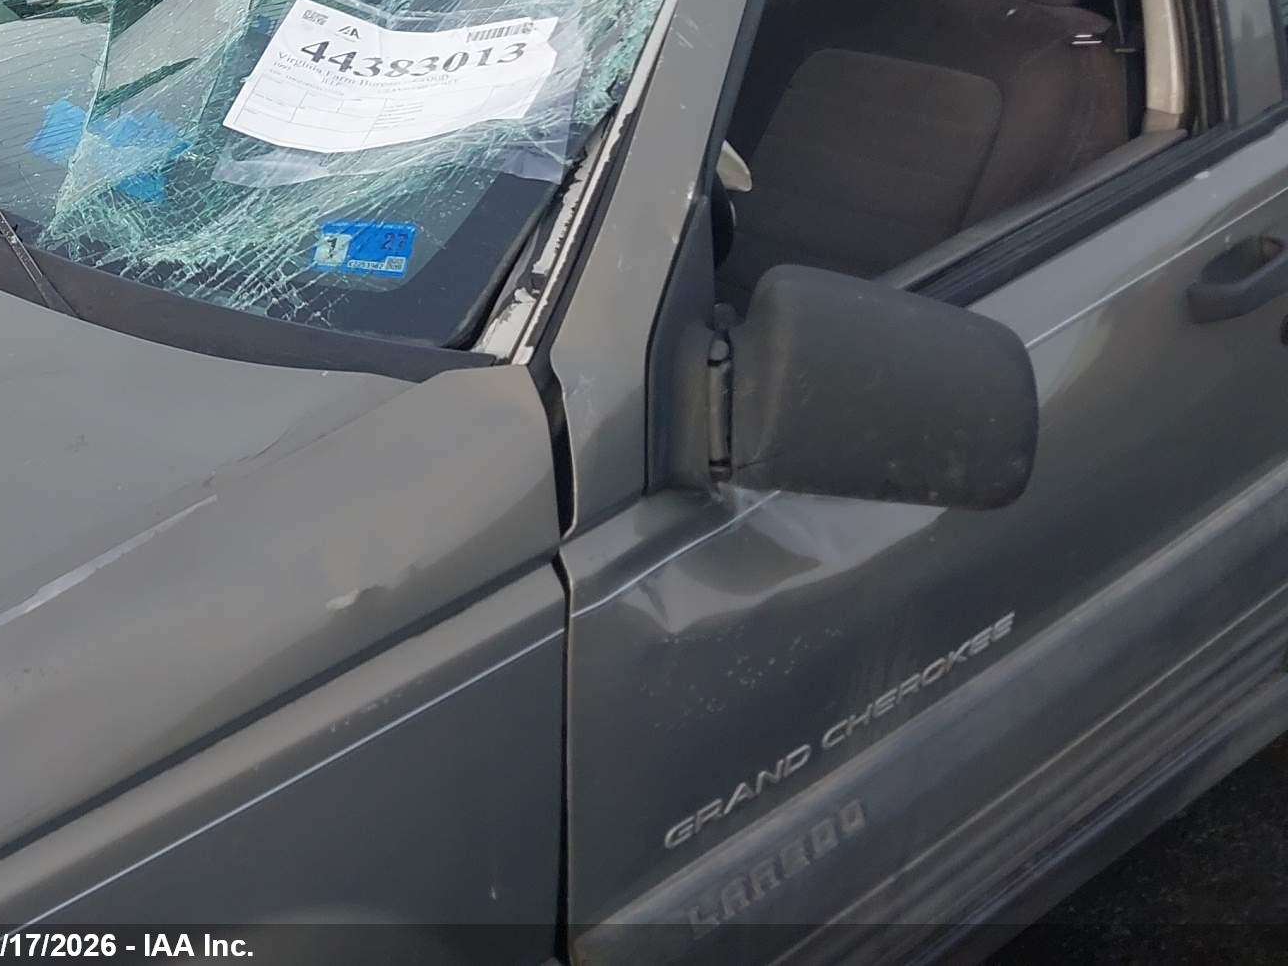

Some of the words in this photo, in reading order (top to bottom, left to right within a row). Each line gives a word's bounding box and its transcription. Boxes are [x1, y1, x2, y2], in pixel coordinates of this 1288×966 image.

[300, 39, 527, 79] 44383013
[663, 743, 812, 850] GRAND
[821, 610, 1017, 750] CHEROKEE
